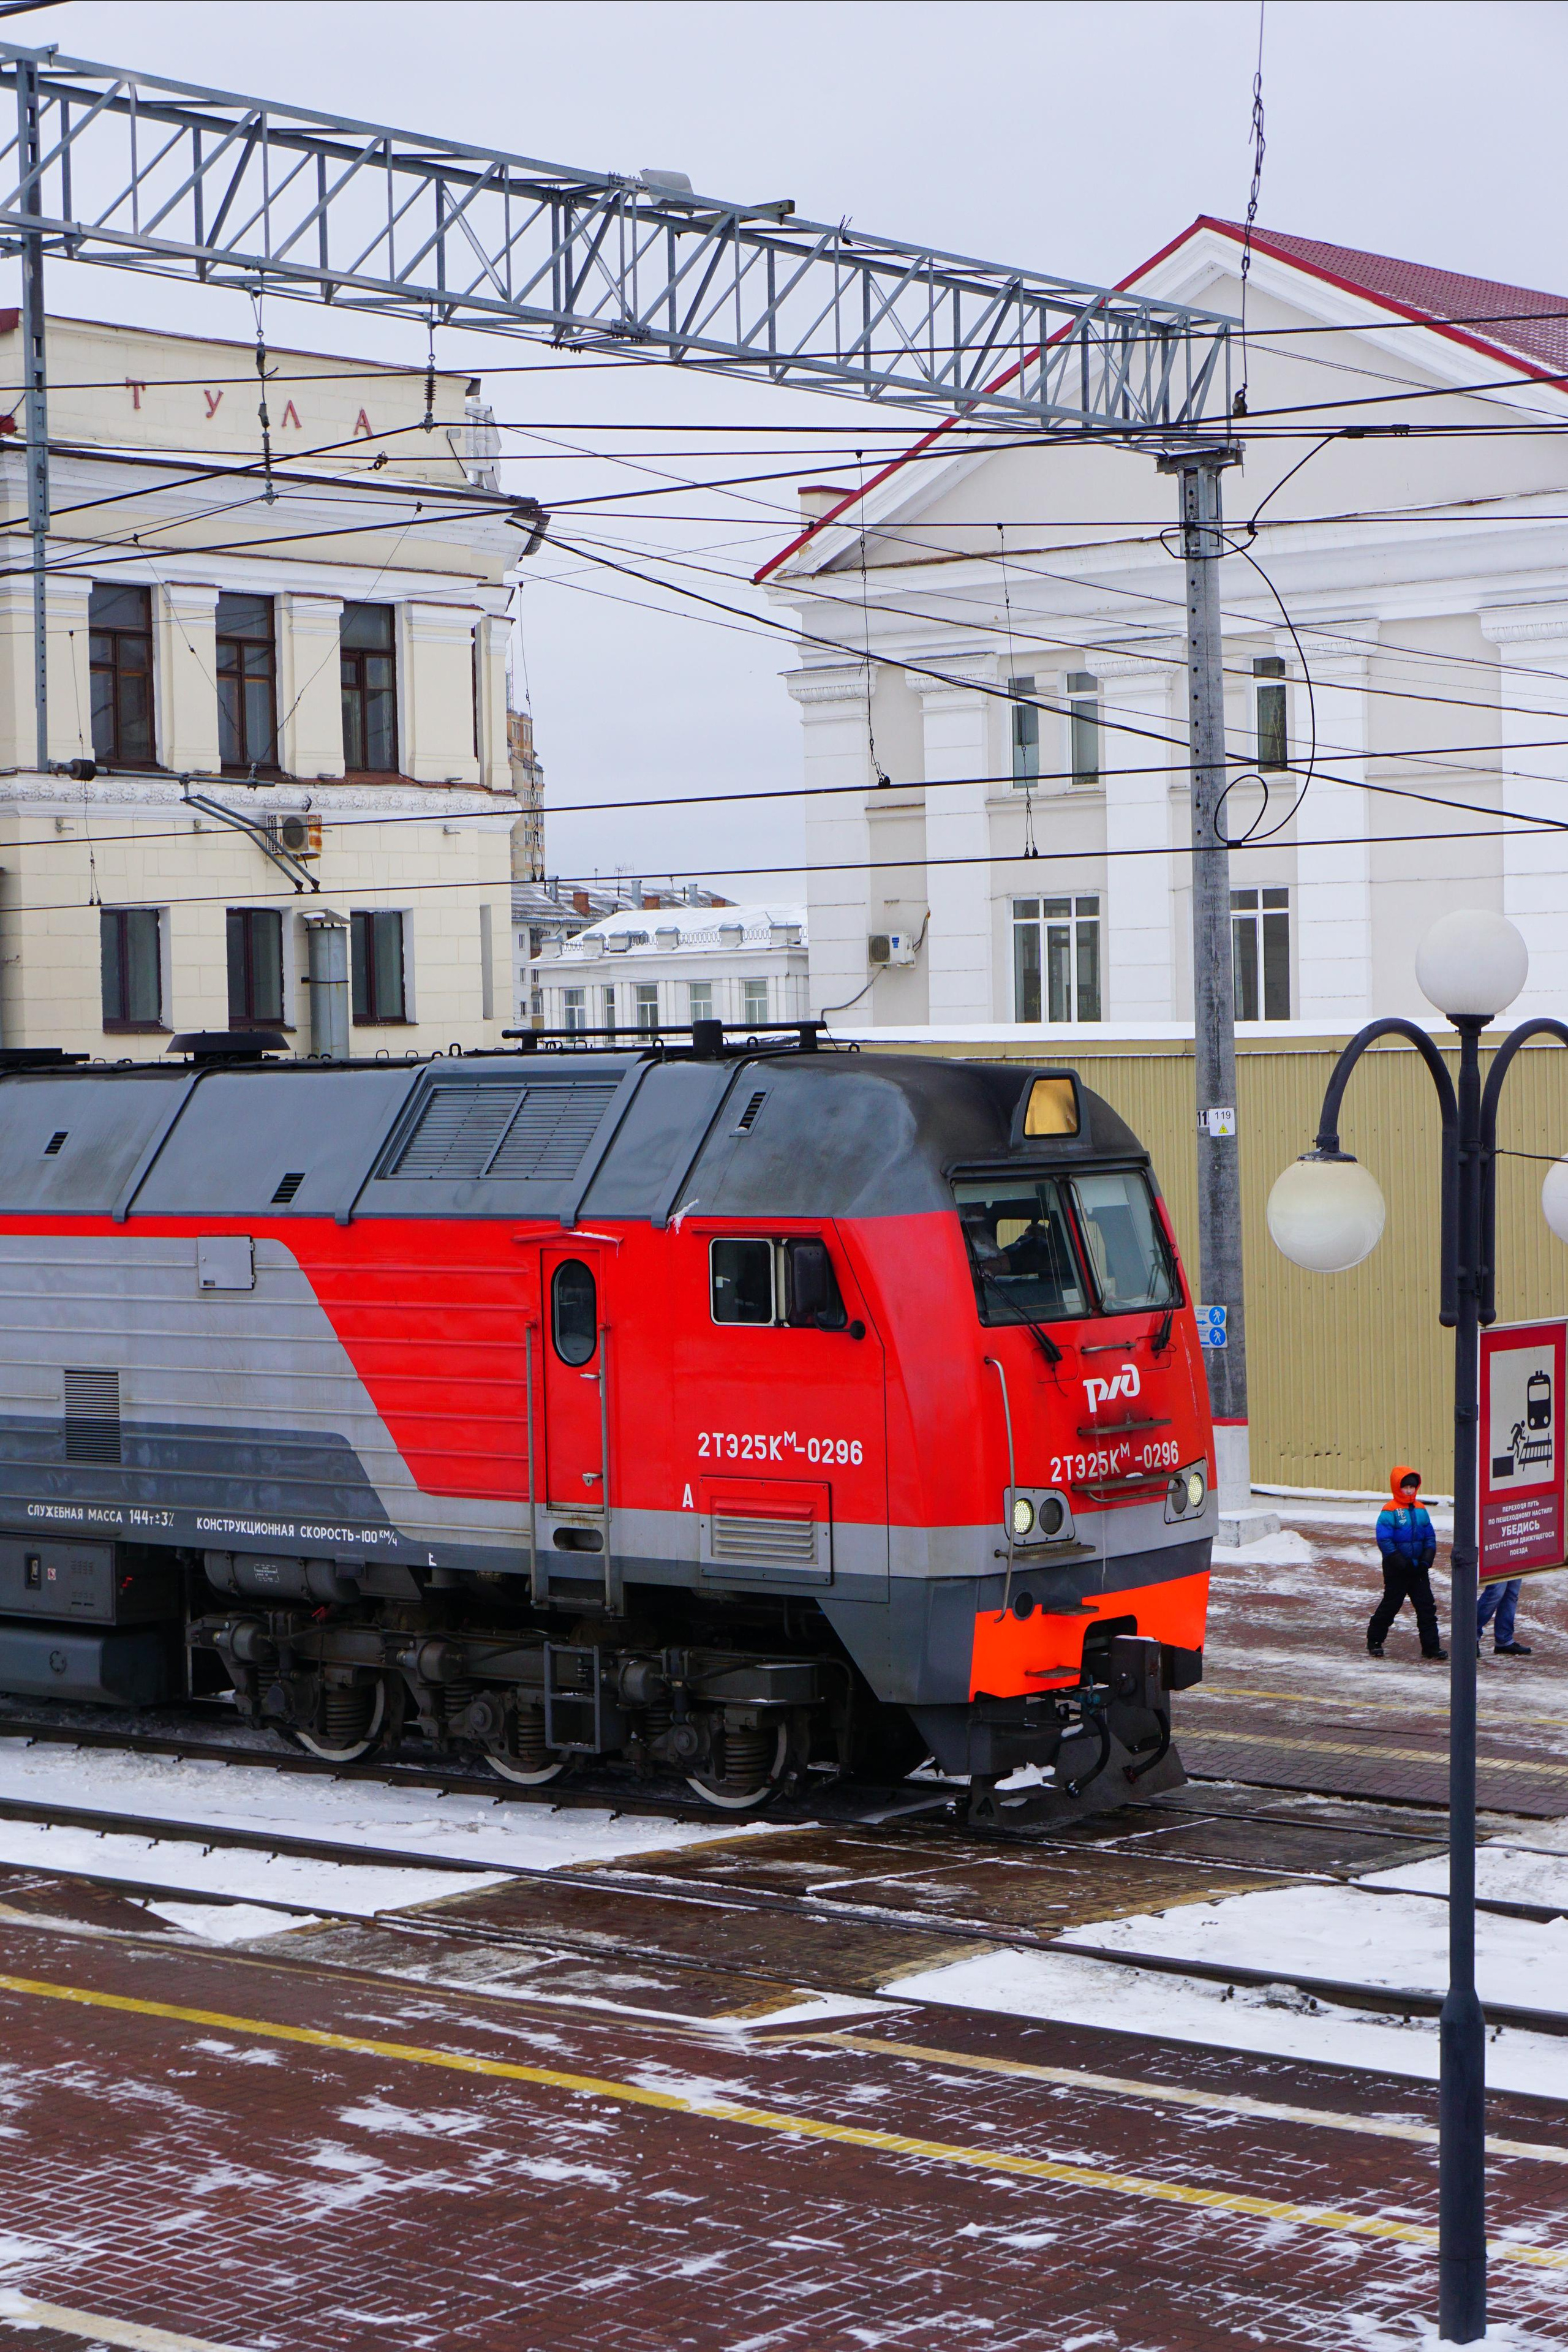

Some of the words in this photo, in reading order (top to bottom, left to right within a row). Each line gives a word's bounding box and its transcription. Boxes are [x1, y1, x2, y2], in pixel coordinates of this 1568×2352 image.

[125, 377, 374, 437] ТУЛА
[1197, 1111, 1210, 1127] 11
[1215, 1110, 1231, 1120] 119
[27, 1504, 83, 1520] СЛУЖЕБНАЯ
[88, 1509, 123, 1523] МАССА
[1496, 1511, 1531, 1524] ПЕШЕХОДНОМУ
[1532, 1507, 1553, 1517] НАСТИЛУ
[1502, 1502, 1526, 1513] ПЕРЕХОДЯ
[197, 1517, 294, 1537] КОНСТРУКЦИОННАЯ
[1501, 1520, 1540, 1537] УБЕДИСЬ
[1489, 1538, 1519, 1550] ОТСУТСТВИИ
[1519, 1531, 1555, 1545] ДВИЖУЩЕГОСЯ
[1509, 1547, 1528, 1556] ПОЕЗДА
